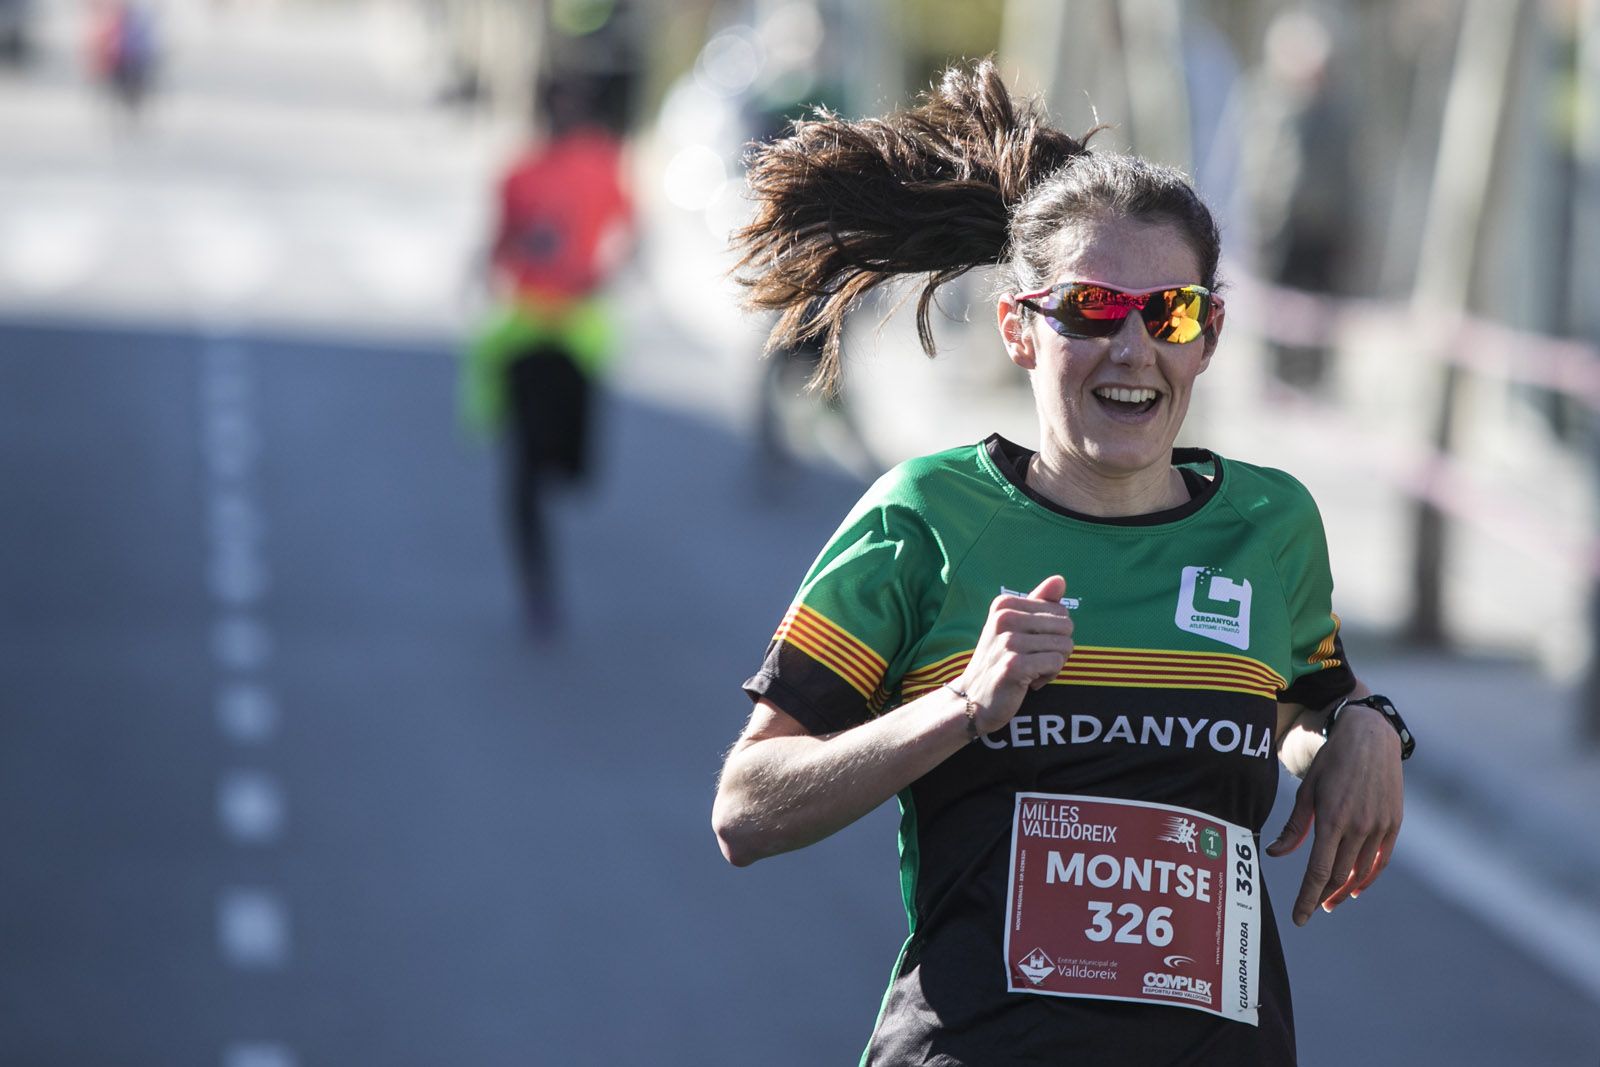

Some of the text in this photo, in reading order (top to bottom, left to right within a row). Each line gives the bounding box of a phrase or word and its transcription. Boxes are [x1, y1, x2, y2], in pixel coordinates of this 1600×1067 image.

[1190, 615, 1240, 628] CERDANYOLA
[1022, 803, 1080, 822] MILLES
[1022, 820, 1118, 843] VALLDOREIX
[1208, 836, 1214, 849] 1
[1046, 850, 1212, 903] MONTSE
[1236, 843, 1253, 896] 326
[1085, 900, 1174, 948] 326
[1057, 965, 1117, 980] Valldoreix
[1079, 959, 1109, 968] Municipal
[1109, 960, 1118, 968] de
[1239, 921, 1249, 1009] GUARDA-ROBA
[1143, 972, 1212, 997] COMPLEX
